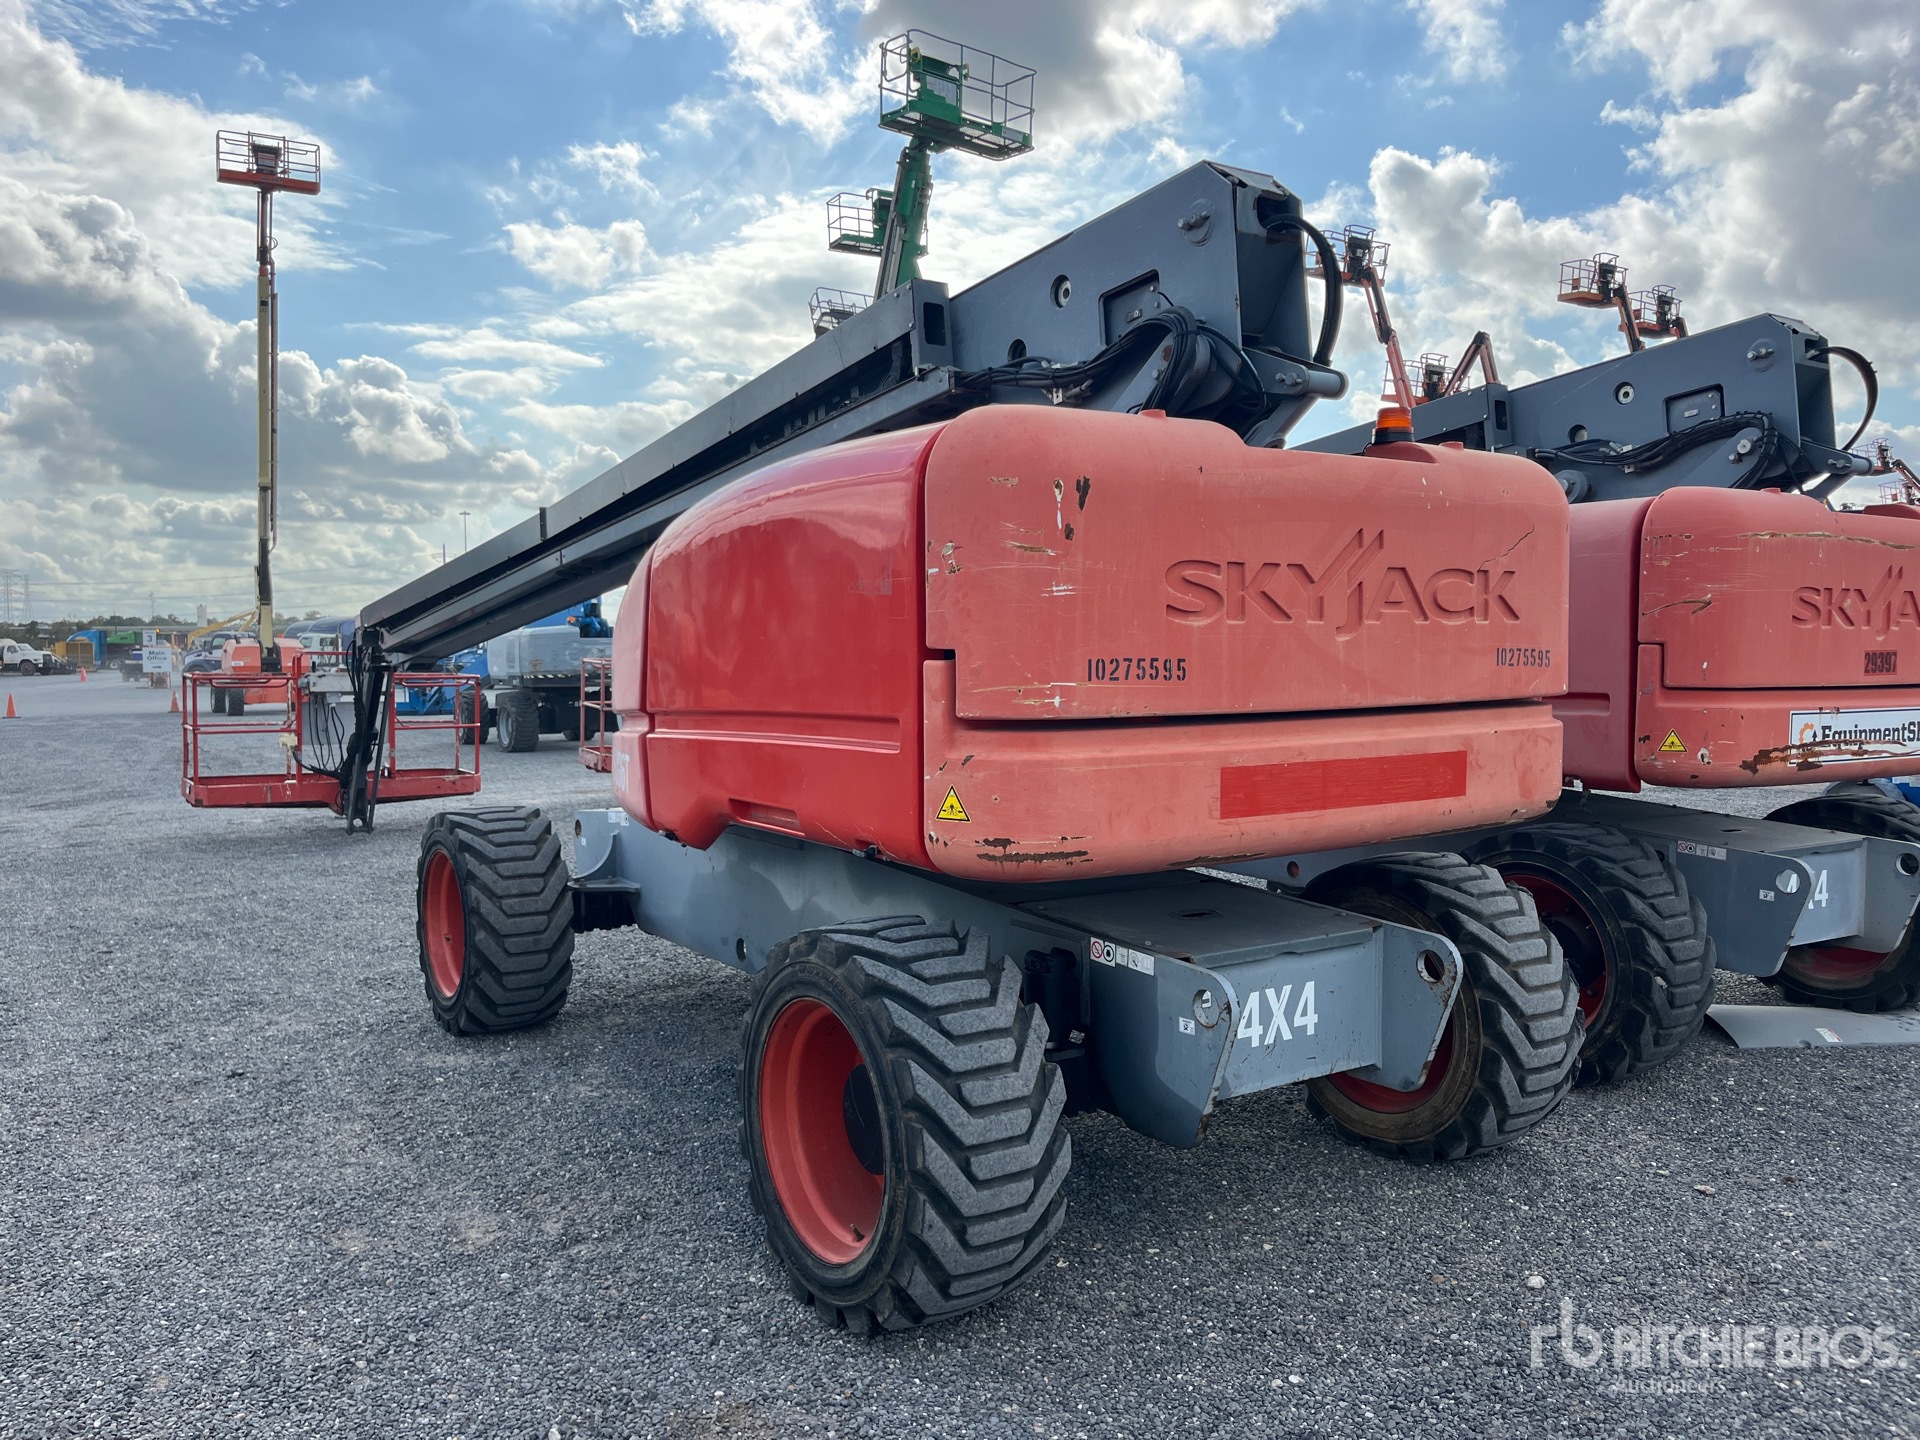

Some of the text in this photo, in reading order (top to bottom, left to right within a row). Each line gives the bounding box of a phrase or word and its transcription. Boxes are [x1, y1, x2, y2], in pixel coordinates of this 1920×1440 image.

[1164, 527, 1521, 641] SKYJACK
[1087, 657, 1187, 682] 10275595
[1496, 647, 1551, 668] 10275595
[1864, 651, 1898, 674] 29397
[1237, 980, 1318, 1048] 4X4
